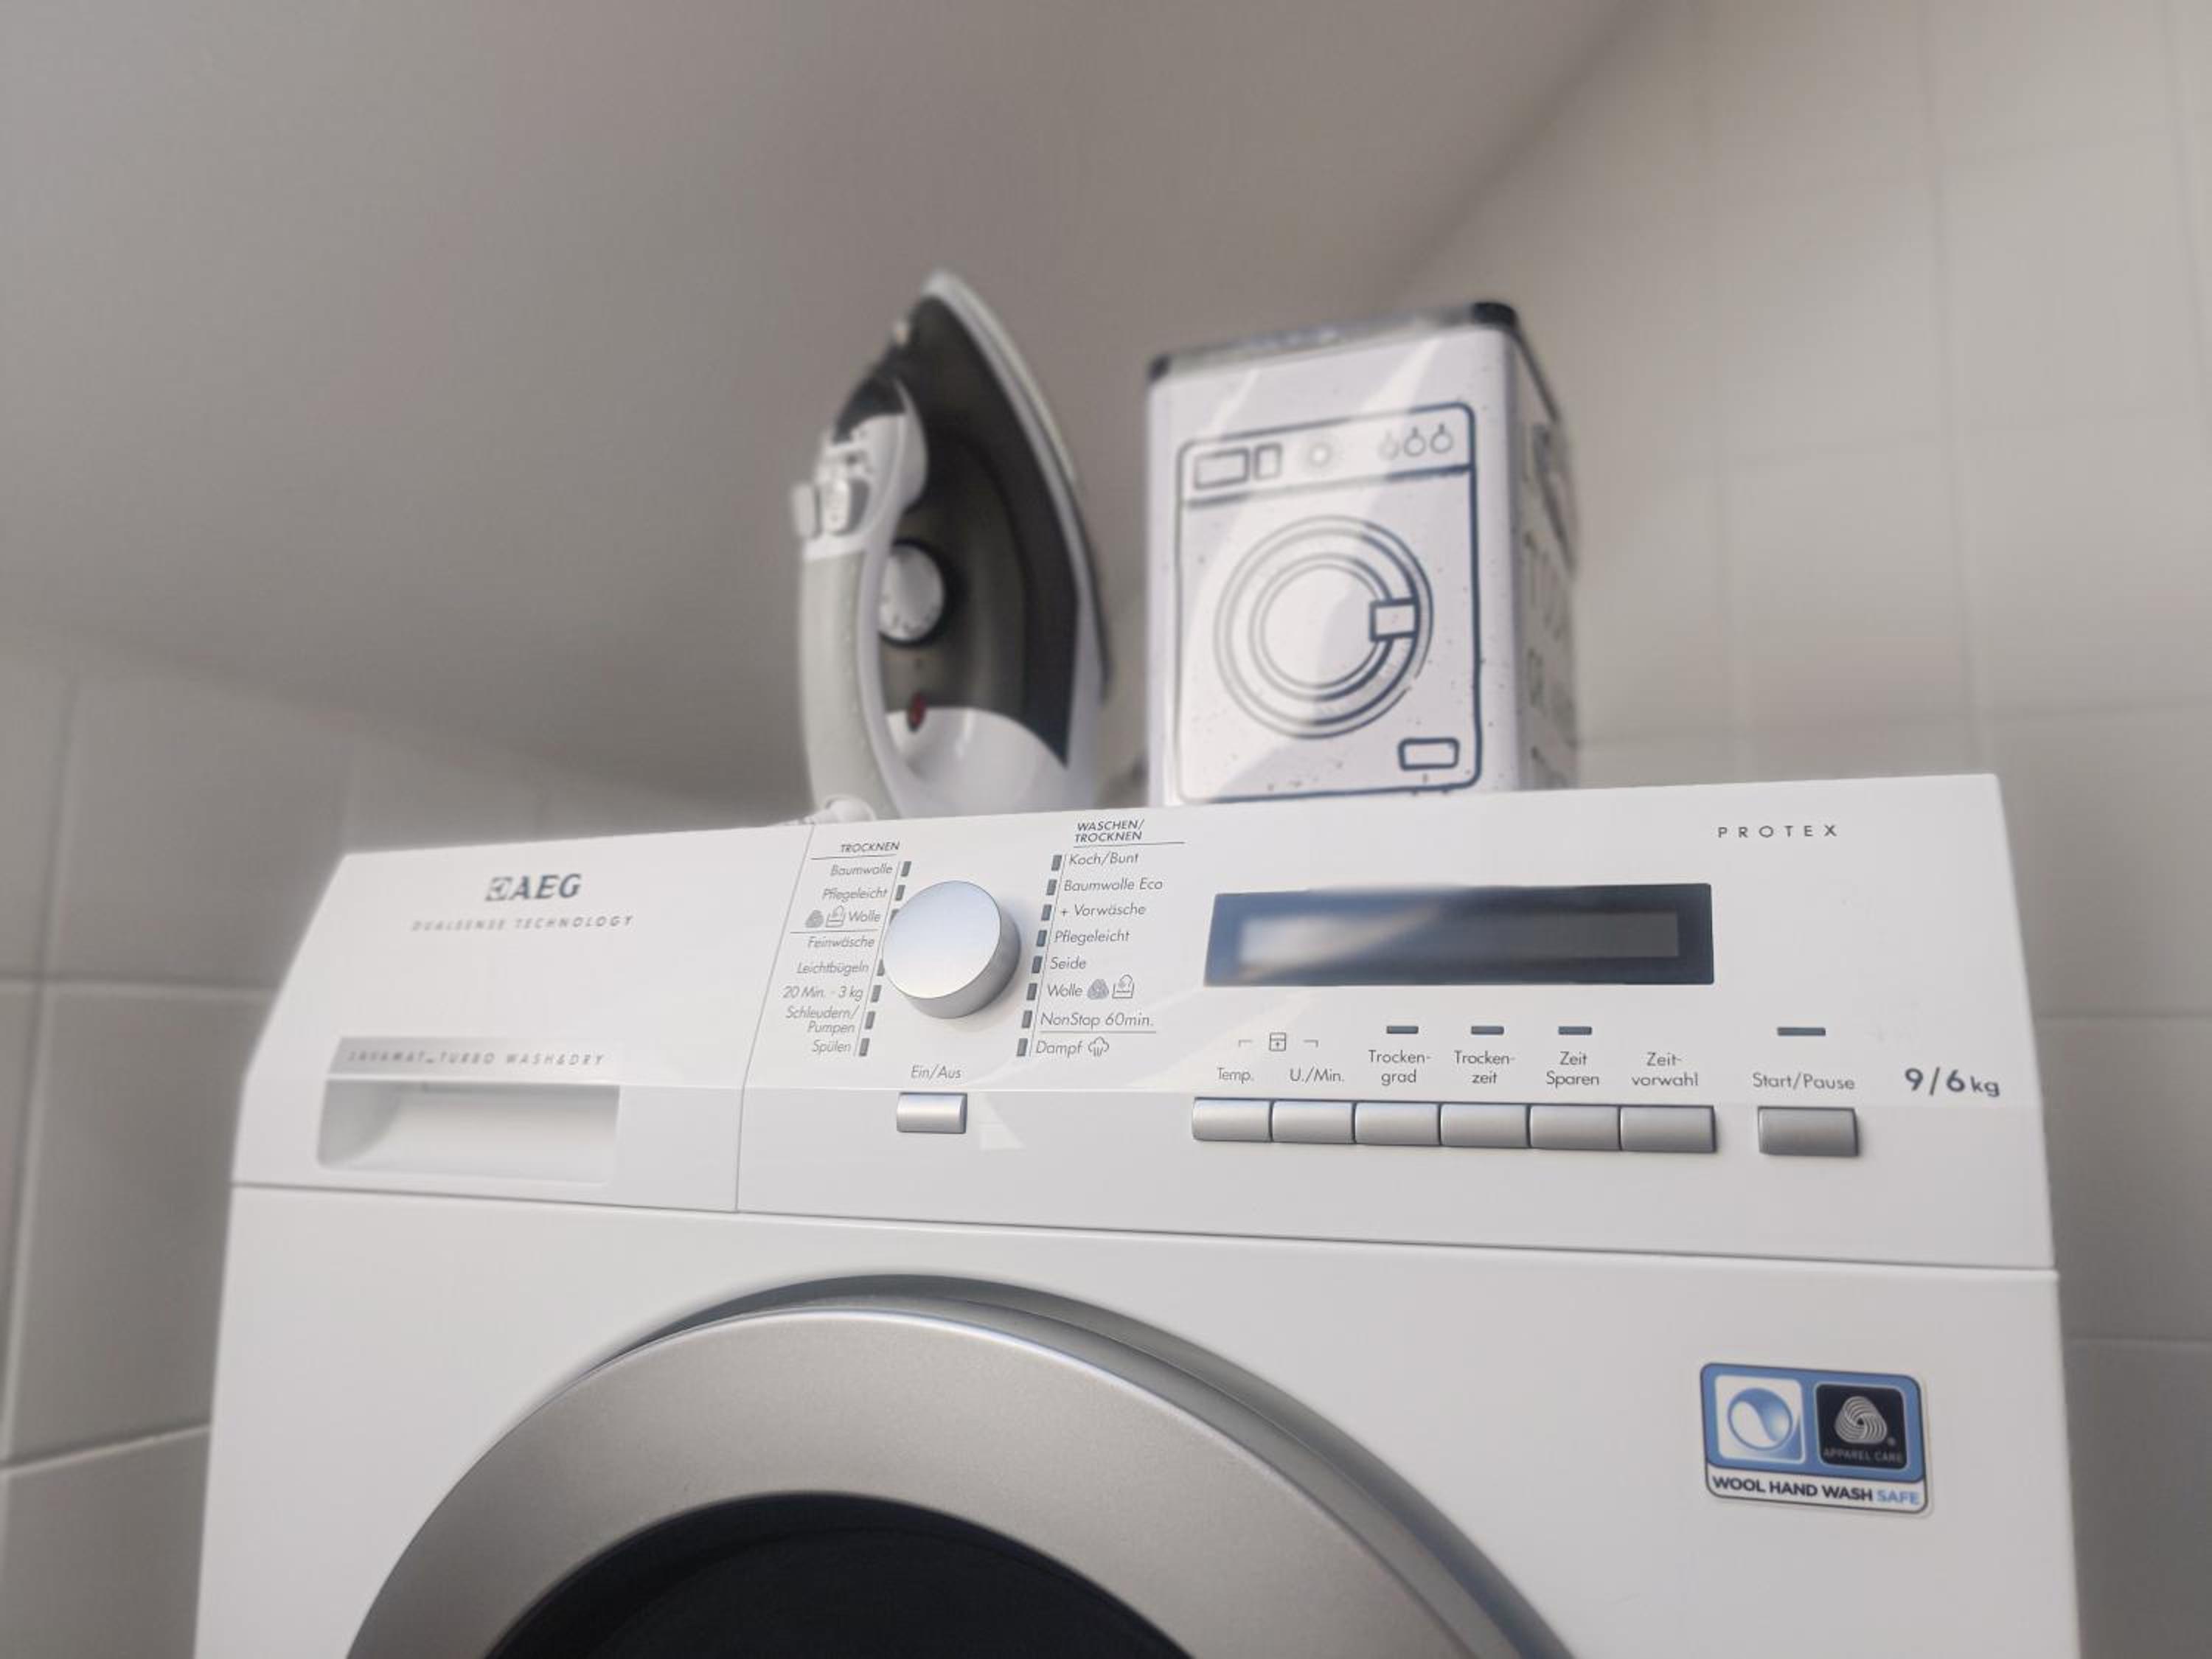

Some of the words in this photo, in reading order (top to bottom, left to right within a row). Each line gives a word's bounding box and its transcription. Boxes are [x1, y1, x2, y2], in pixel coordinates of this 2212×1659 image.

[1077, 819, 1144, 832] WASCHEN/
[1717, 824, 1837, 838] PROTEX
[1074, 831, 1142, 843] TROCKNEN
[841, 841, 900, 853] TROCKNEN
[1069, 852, 1139, 866] Koch/Bunt
[830, 863, 893, 877] Baumwolle
[511, 873, 582, 900] AEG
[1064, 878, 1135, 891] Baumwolle
[1139, 877, 1163, 890] Eco
[821, 888, 887, 902] Pflegeleicht
[849, 910, 881, 922] Wolle
[1074, 904, 1147, 917] Vorwäsche
[515, 916, 634, 929] TECHNOLOGY
[808, 936, 875, 948] Feinwäsche
[1054, 931, 1130, 947] Pflegeleicht
[796, 961, 869, 977] Leichtbügeln
[1049, 956, 1087, 970] Seide
[782, 985, 801, 999] 20
[838, 985, 847, 998] 3
[849, 985, 863, 1001] kg
[1048, 983, 1083, 997] Wolle
[785, 1005, 860, 1019] Schleudern/
[807, 1020, 855, 1035] Pumpen
[1040, 1012, 1100, 1030] NonStop
[812, 1039, 851, 1055] Spülen
[1036, 1040, 1083, 1057] Dampf
[1369, 1049, 1433, 1063] Trocken-
[1455, 1049, 1516, 1065] Trocken-
[1559, 1051, 1587, 1065] Zeit
[1646, 1051, 1682, 1067] Zeit-
[911, 1065, 961, 1079] Ein/Aus
[1217, 1067, 1254, 1085] Temp.
[1290, 1067, 1344, 1084] U./Min.
[1381, 1069, 1417, 1085] grad
[1472, 1071, 1498, 1085] zeit
[1632, 1071, 1698, 1087] vorwahl
[1546, 1071, 1599, 1088] Sparen
[1753, 1072, 1856, 1091] Start/Pause
[1712, 1476, 1767, 1492] WOOL
[1769, 1481, 1818, 1497] HAND
[1822, 1486, 1873, 1501] WASH
[1877, 1489, 1920, 1505] SAFE
